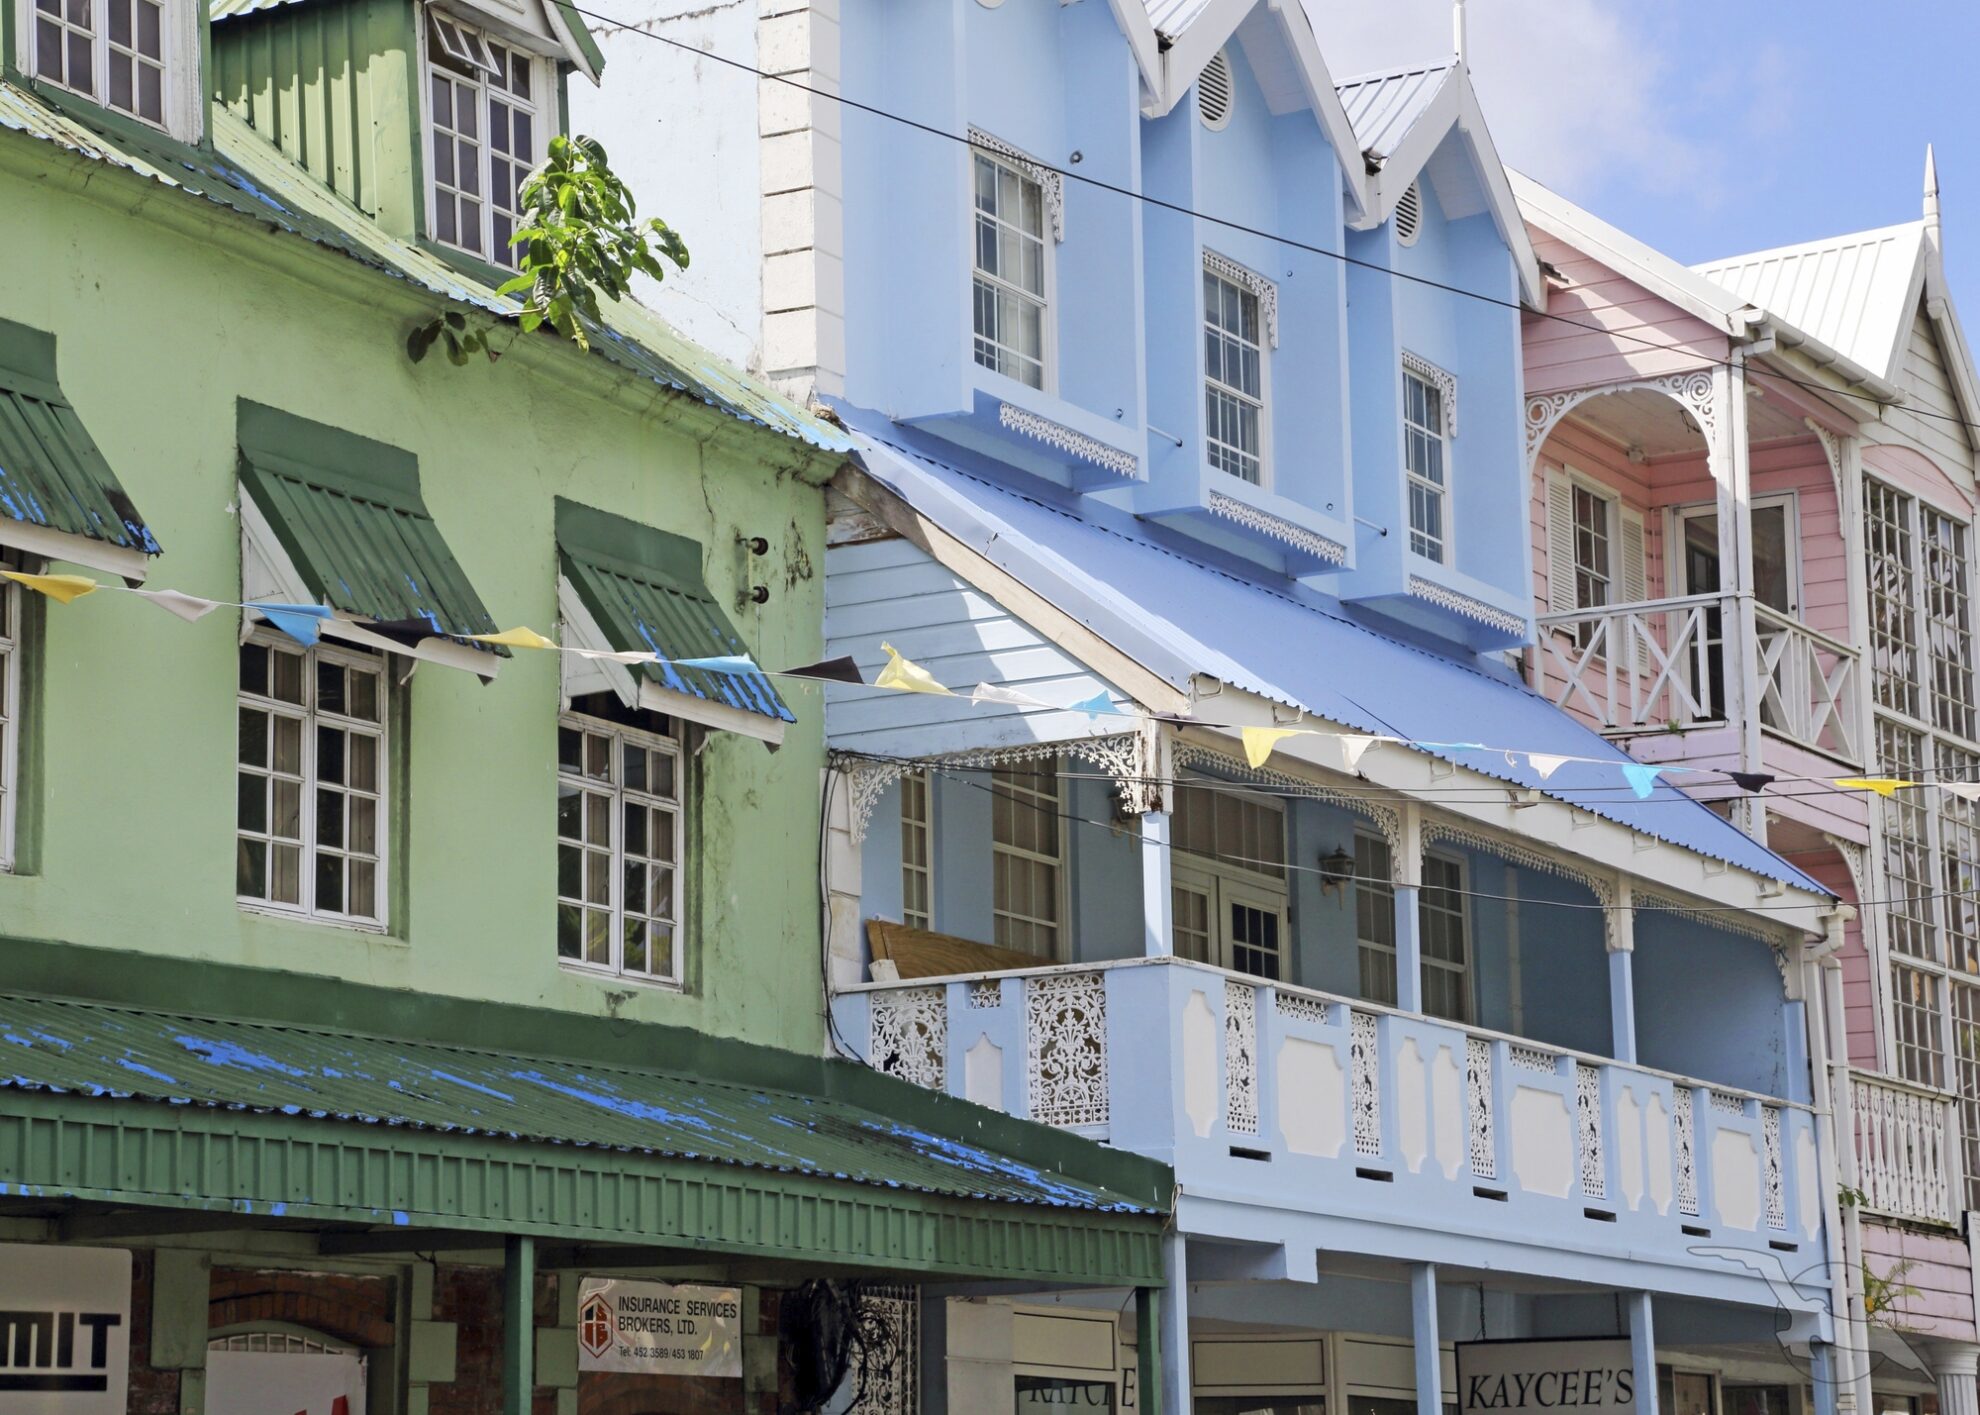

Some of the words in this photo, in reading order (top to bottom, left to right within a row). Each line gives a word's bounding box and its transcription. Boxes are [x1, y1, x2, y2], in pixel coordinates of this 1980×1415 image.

[618, 1296, 681, 1314] INSURANCE
[686, 1302, 737, 1319] SERVICES
[618, 1316, 673, 1336] BROKERS,
[677, 1319, 698, 1335] LTD.
[687, 1350, 704, 1361] 1807
[1466, 1368, 1634, 1409] KAYCEE'S
